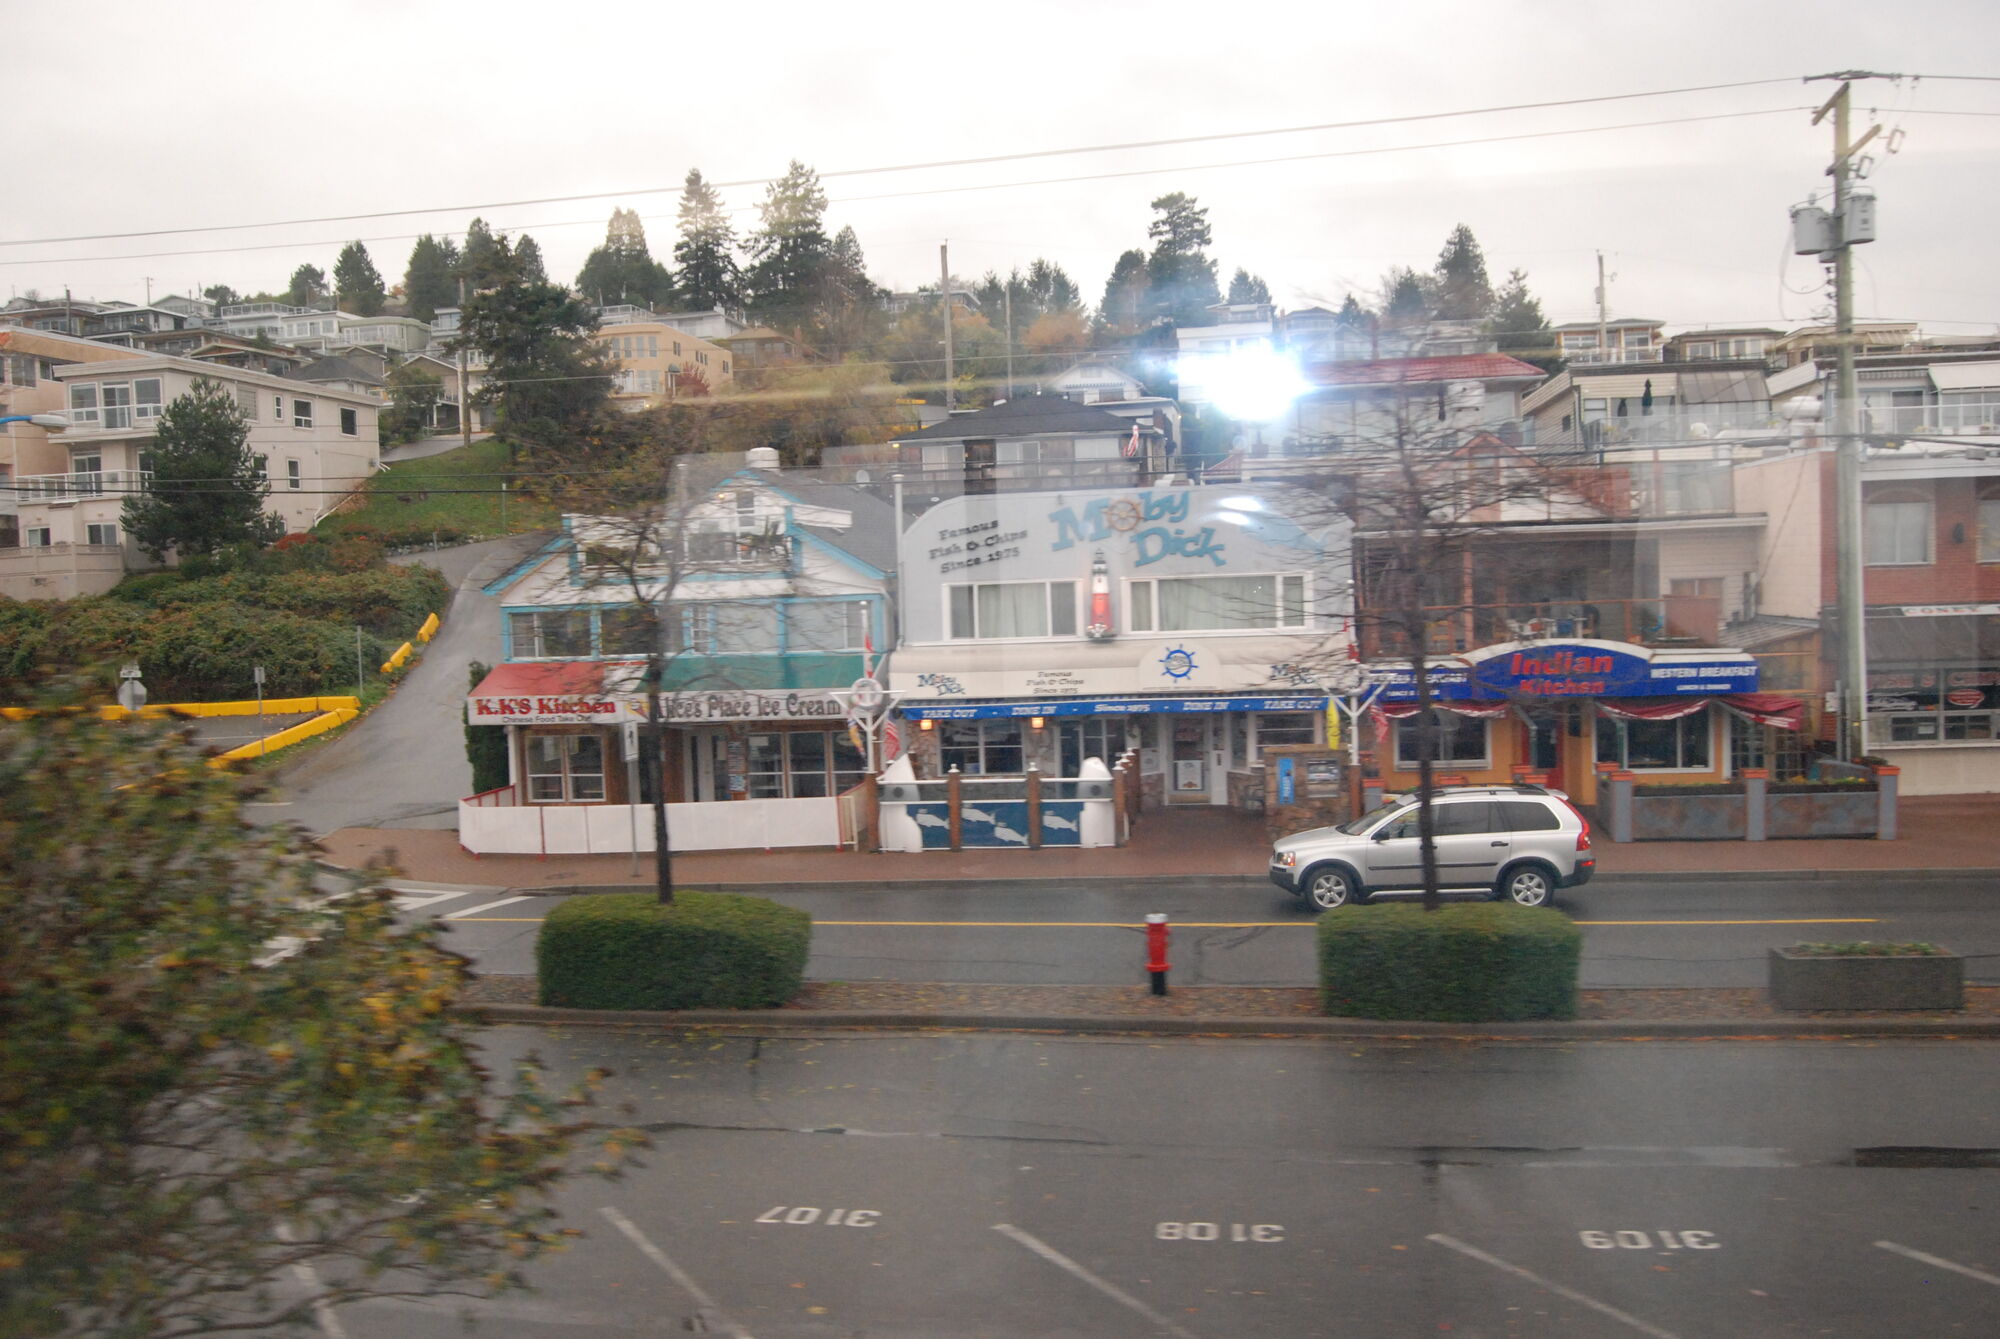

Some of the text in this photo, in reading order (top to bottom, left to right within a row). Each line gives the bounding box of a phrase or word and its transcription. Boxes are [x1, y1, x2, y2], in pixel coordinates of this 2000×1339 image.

[939, 519, 999, 541] Famous
[1048, 491, 1190, 551] Moby
[929, 528, 1029, 560] Fish & Chips
[1130, 526, 1227, 568] Dick
[940, 546, 1021, 574] Since 1975
[1511, 651, 1614, 675] Indian
[1650, 665, 1759, 679] WESTERN BREAKFAST
[1519, 678, 1605, 695] Kitchen
[537, 696, 616, 714] Kitchen
[707, 695, 750, 718] Place
[757, 695, 780, 717] Ice
[786, 693, 841, 716] Cream
[922, 709, 951, 718] TAKE
[953, 708, 978, 717] OUT
[1264, 701, 1295, 709] TAKE
[535, 715, 556, 723] Food
[558, 714, 574, 722] Take
[1155, 1221, 1286, 1243] 3108
[1579, 1230, 1722, 1250] 3109
